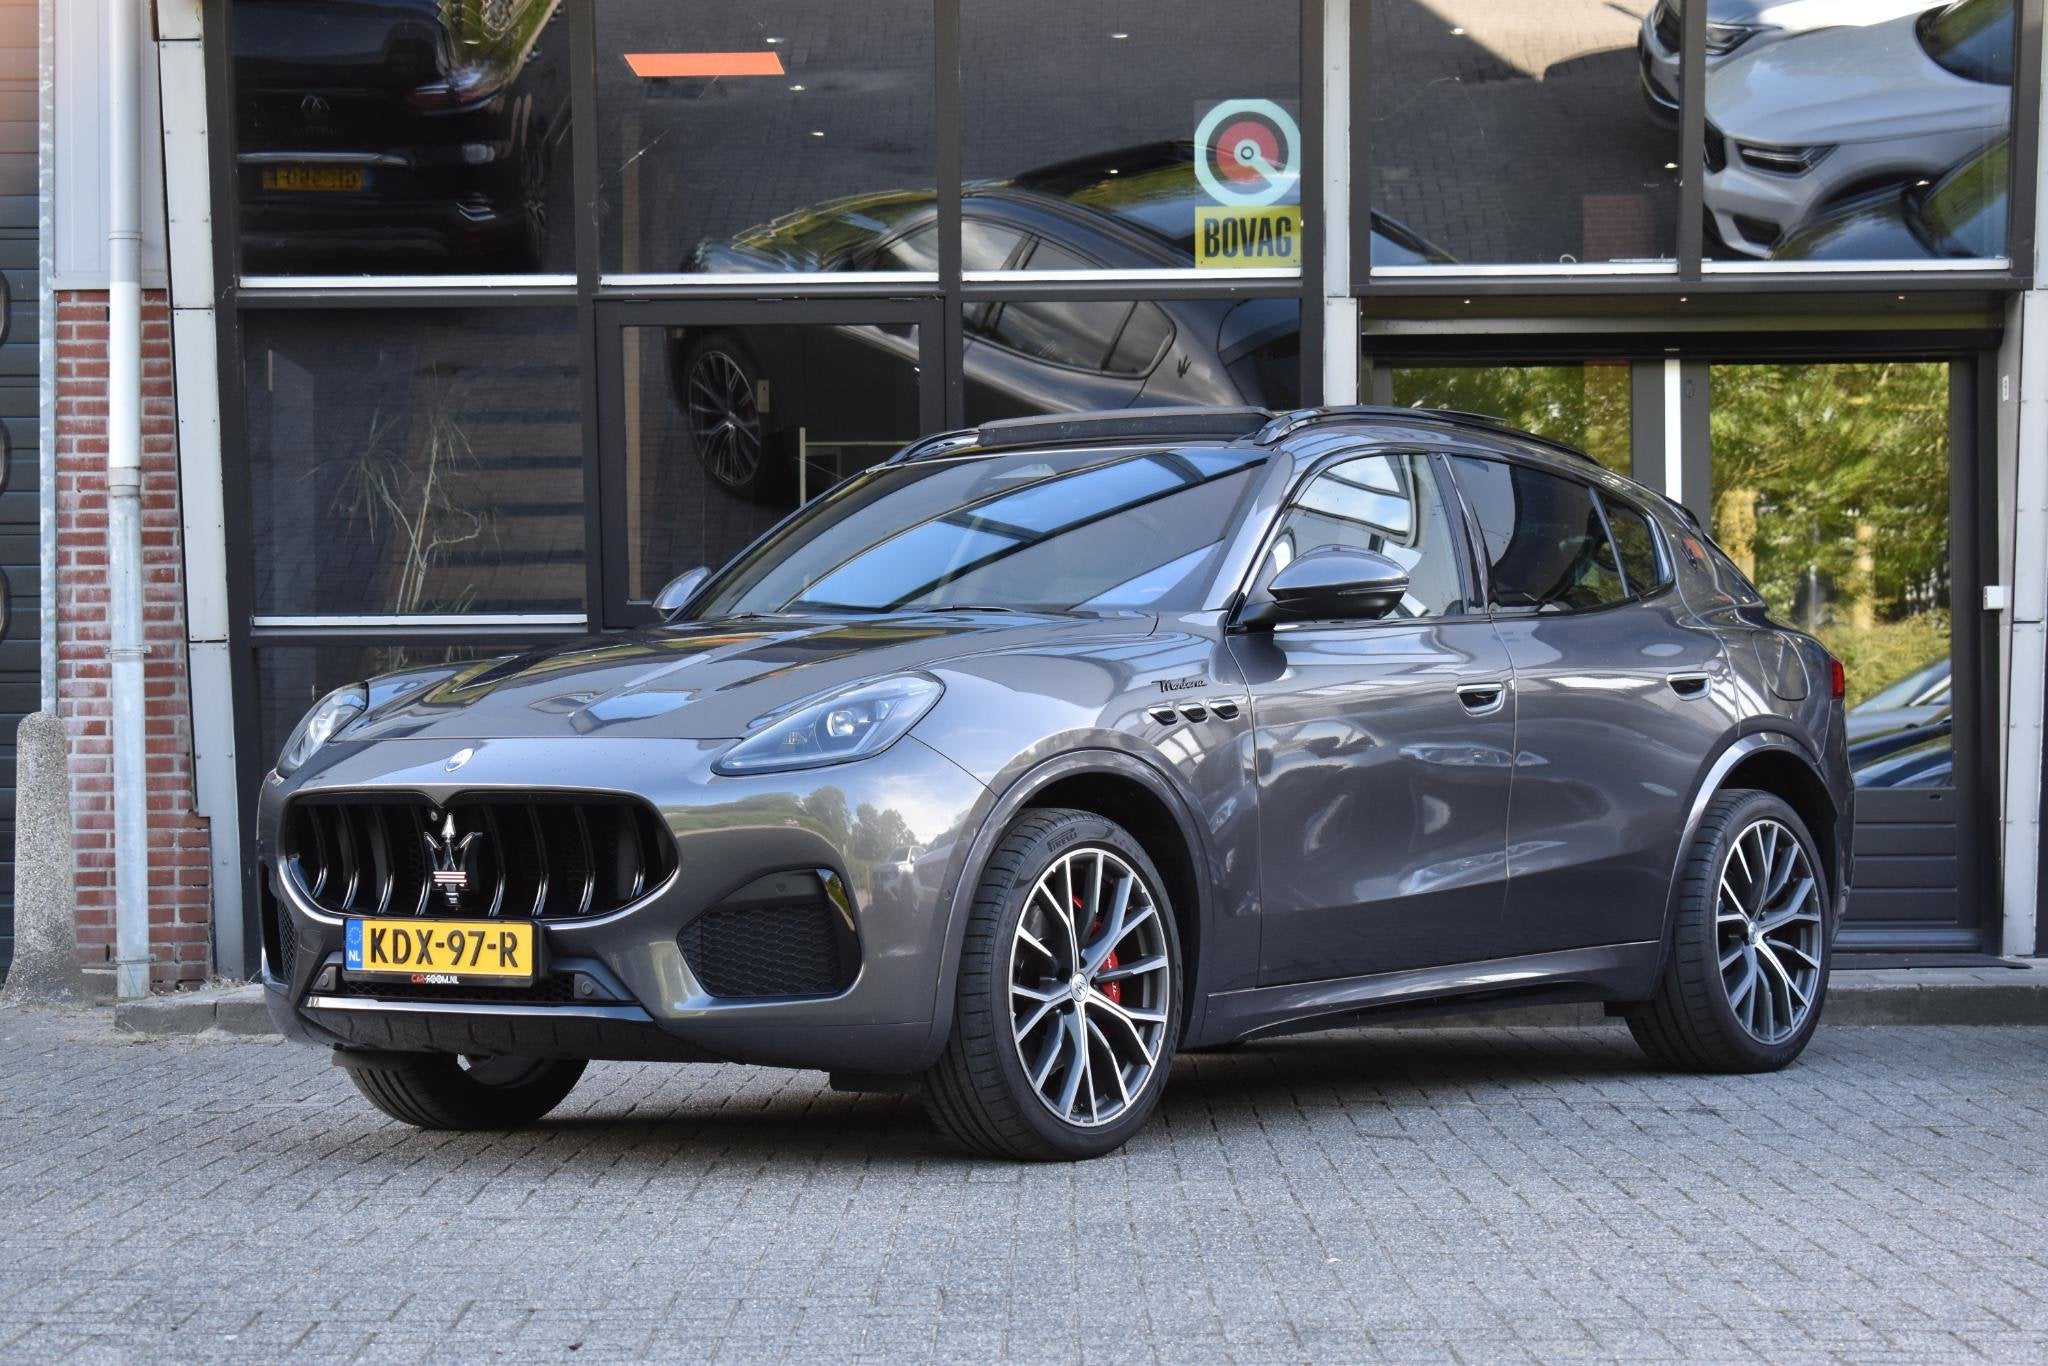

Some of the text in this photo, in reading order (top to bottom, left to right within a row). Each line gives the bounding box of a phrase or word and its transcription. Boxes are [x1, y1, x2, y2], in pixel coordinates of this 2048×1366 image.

[1204, 216, 1292, 257] BOVAG
[348, 951, 361, 962] NL
[370, 927, 519, 968] KDX-97-R
